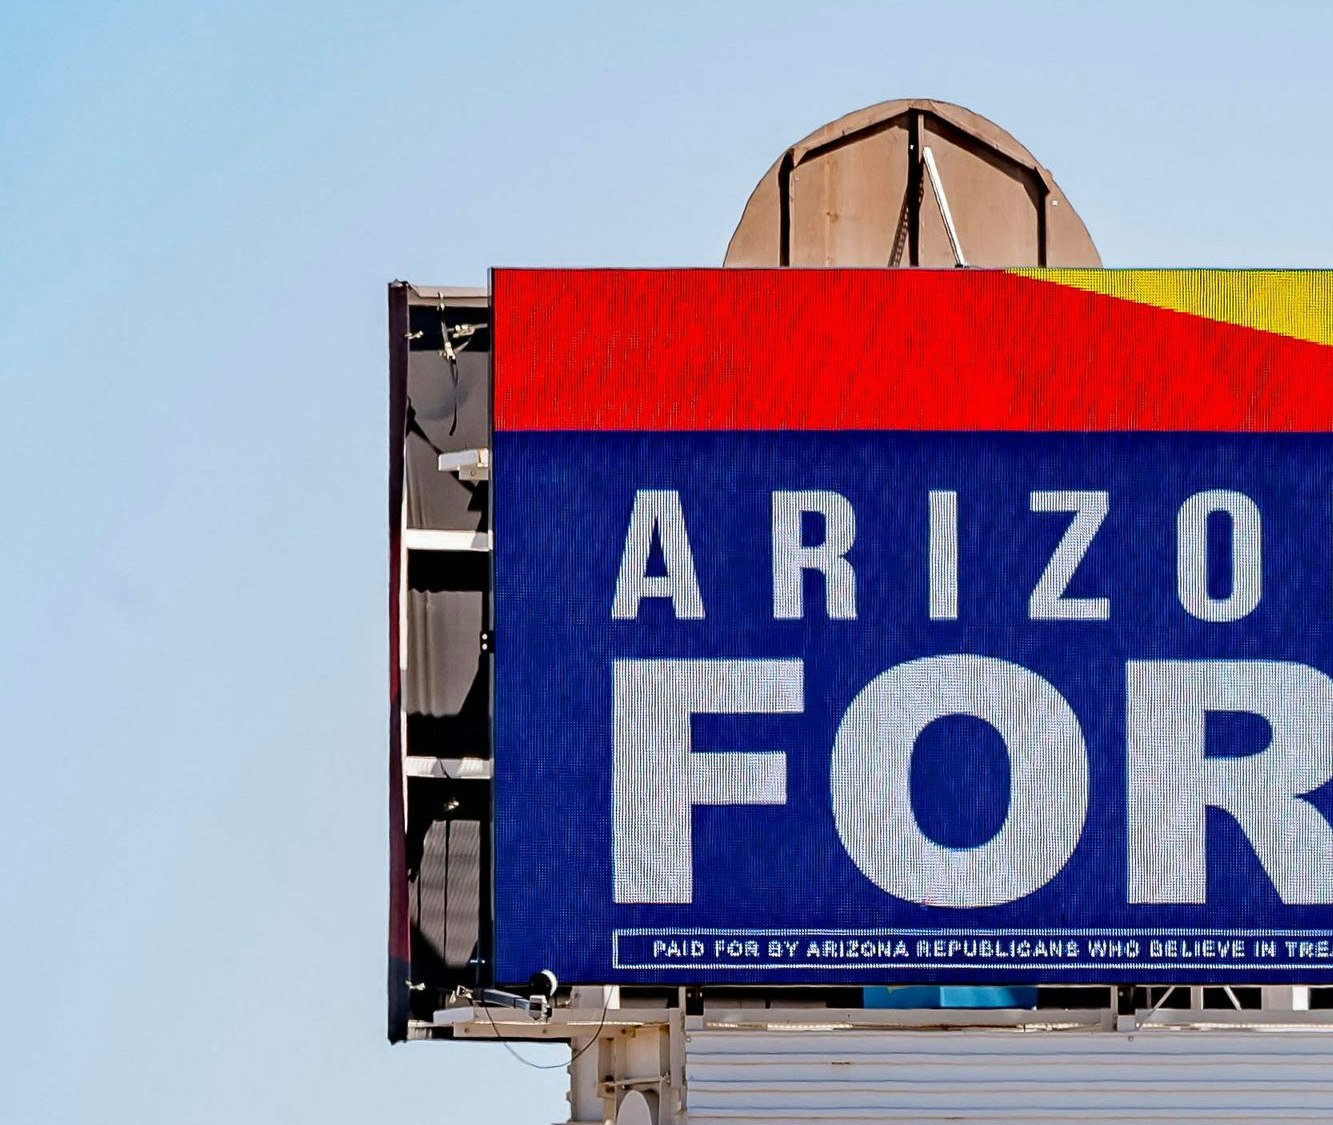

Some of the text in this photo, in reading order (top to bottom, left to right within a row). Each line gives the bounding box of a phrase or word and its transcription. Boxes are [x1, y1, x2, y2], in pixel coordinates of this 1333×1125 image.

[652, 940, 706, 958] PAID
[714, 940, 760, 958] FOR
[768, 940, 799, 958] BY
[806, 940, 909, 958] ARIZONA
[916, 940, 1080, 959] REPUBLICANS
[1087, 940, 1140, 959] WHO
[1149, 940, 1245, 959] BELIEVE
[1255, 941, 1277, 959] IN
